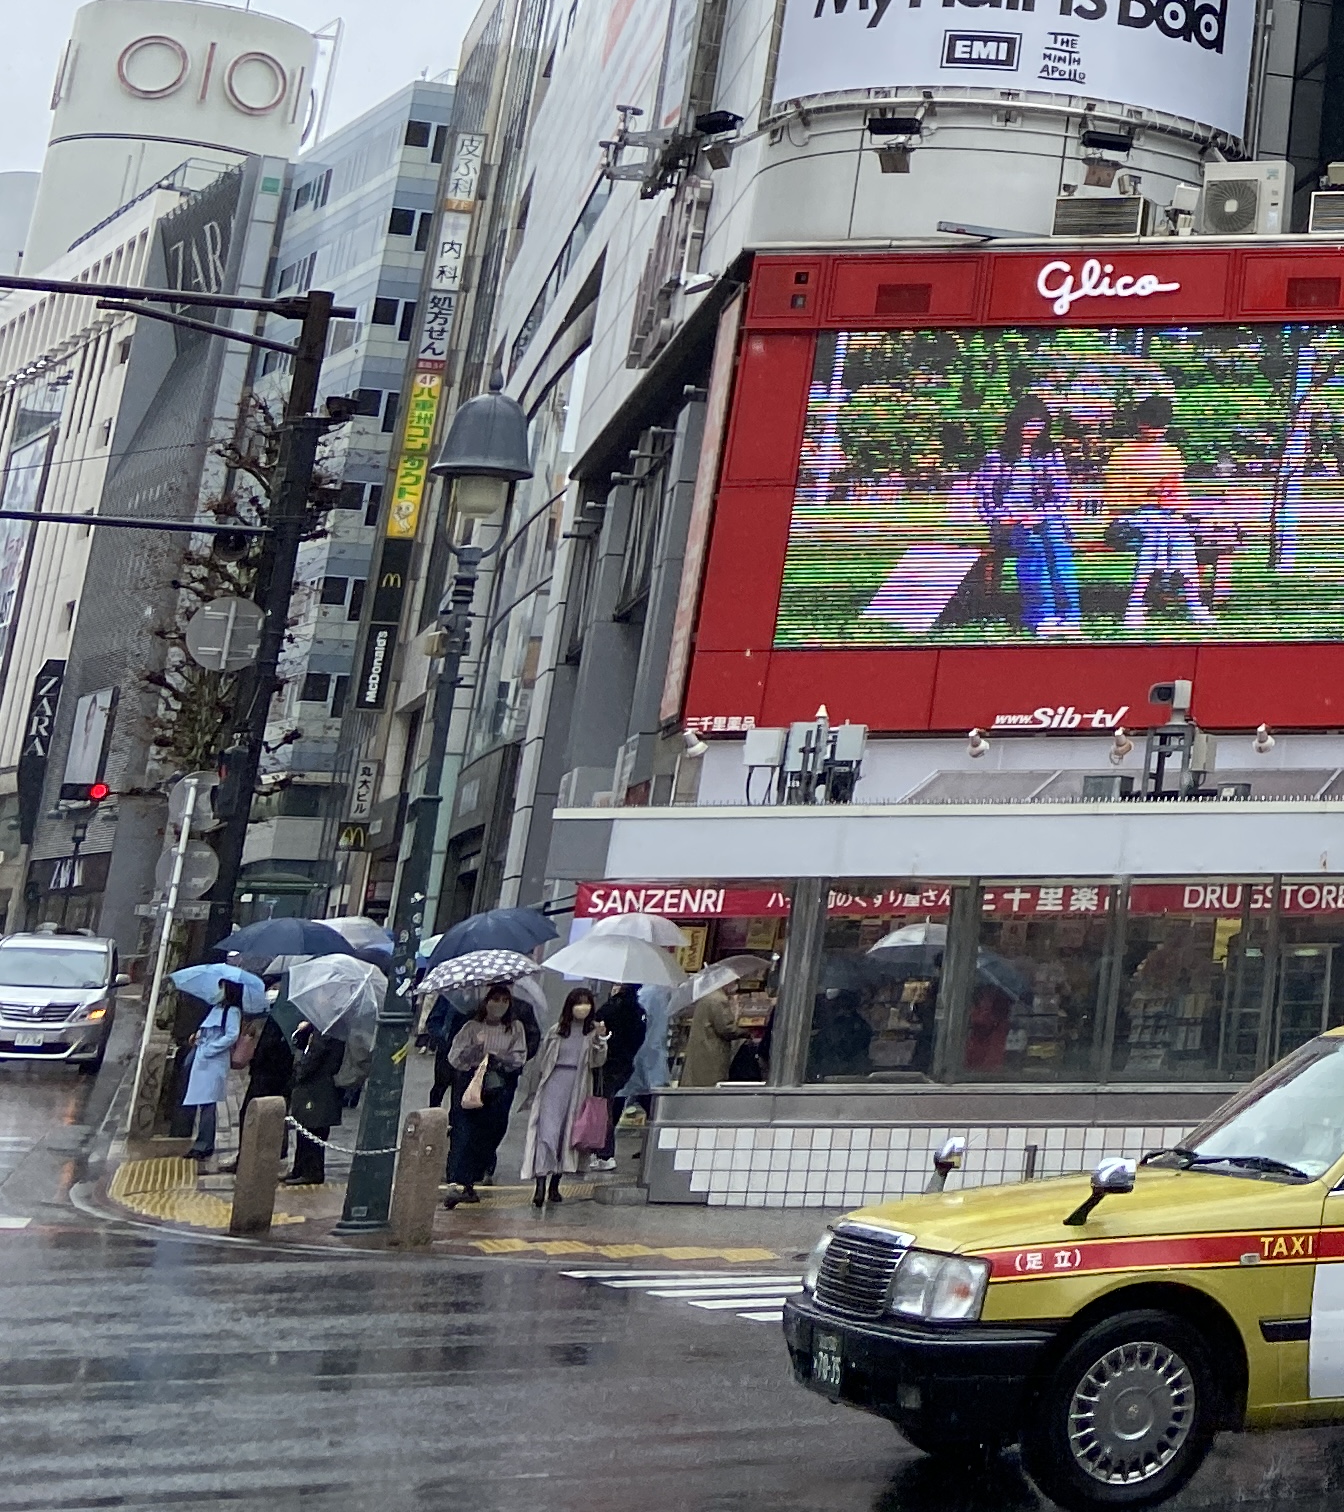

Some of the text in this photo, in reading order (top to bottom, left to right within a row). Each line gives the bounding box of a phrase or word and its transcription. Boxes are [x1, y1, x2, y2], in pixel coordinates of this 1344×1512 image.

[952, 38, 1009, 62] EMI
[452, 137, 483, 199] 皮ふ科
[169, 215, 236, 316] ZAR
[436, 239, 463, 285] 内科
[1036, 258, 1181, 316] Glico
[420, 294, 454, 358] 処方せん
[418, 375, 437, 387] 4F
[364, 630, 389, 704] McDonald's
[22, 674, 60, 758] ZARA
[353, 766, 374, 815] 丸大ビル
[587, 888, 726, 913] SANZENRI
[1260, 1236, 1315, 1259] TAXI
